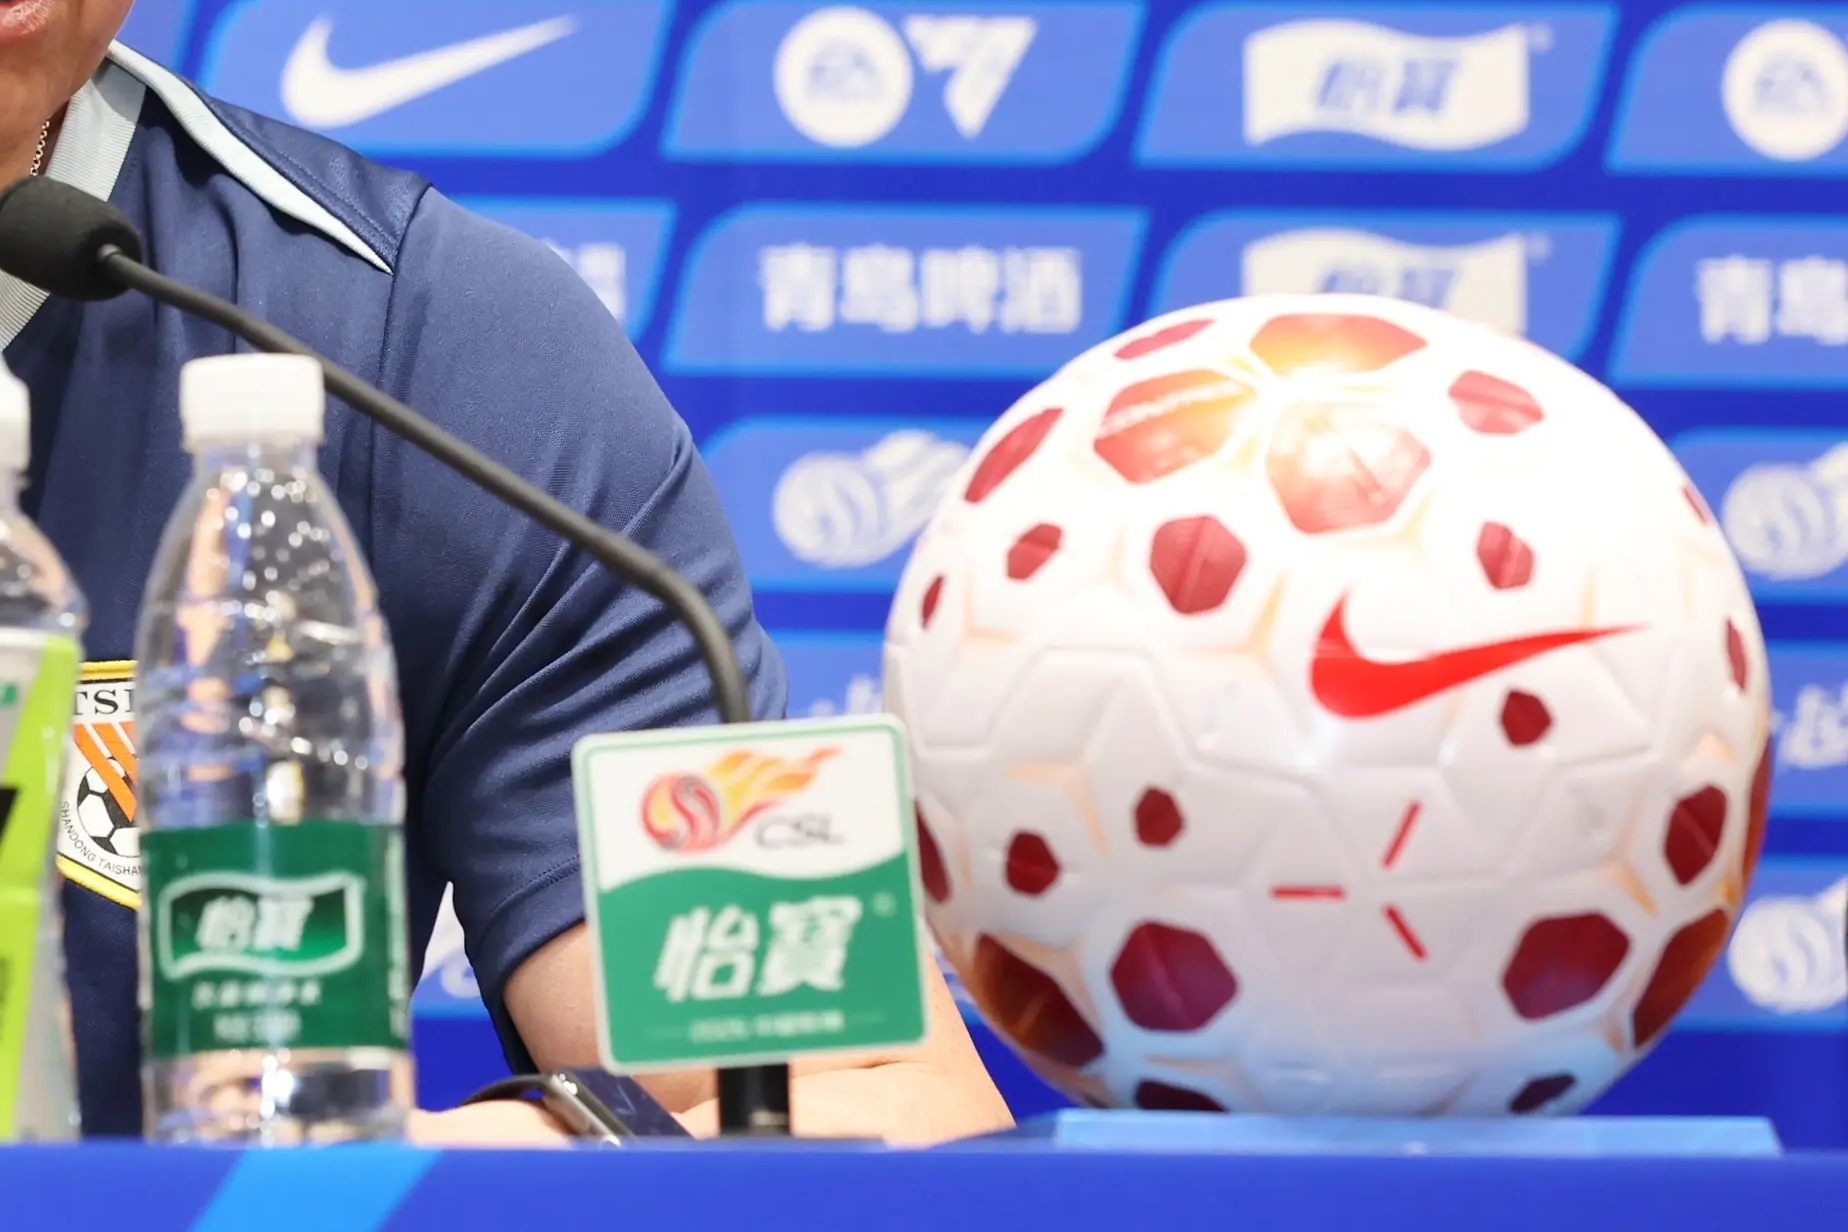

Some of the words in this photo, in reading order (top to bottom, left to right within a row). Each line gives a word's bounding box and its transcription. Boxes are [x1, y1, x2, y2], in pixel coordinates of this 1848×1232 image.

[56, 801, 97, 862] SHANDONG
[98, 856, 142, 876] TAISHA
[755, 813, 845, 850] CSL
